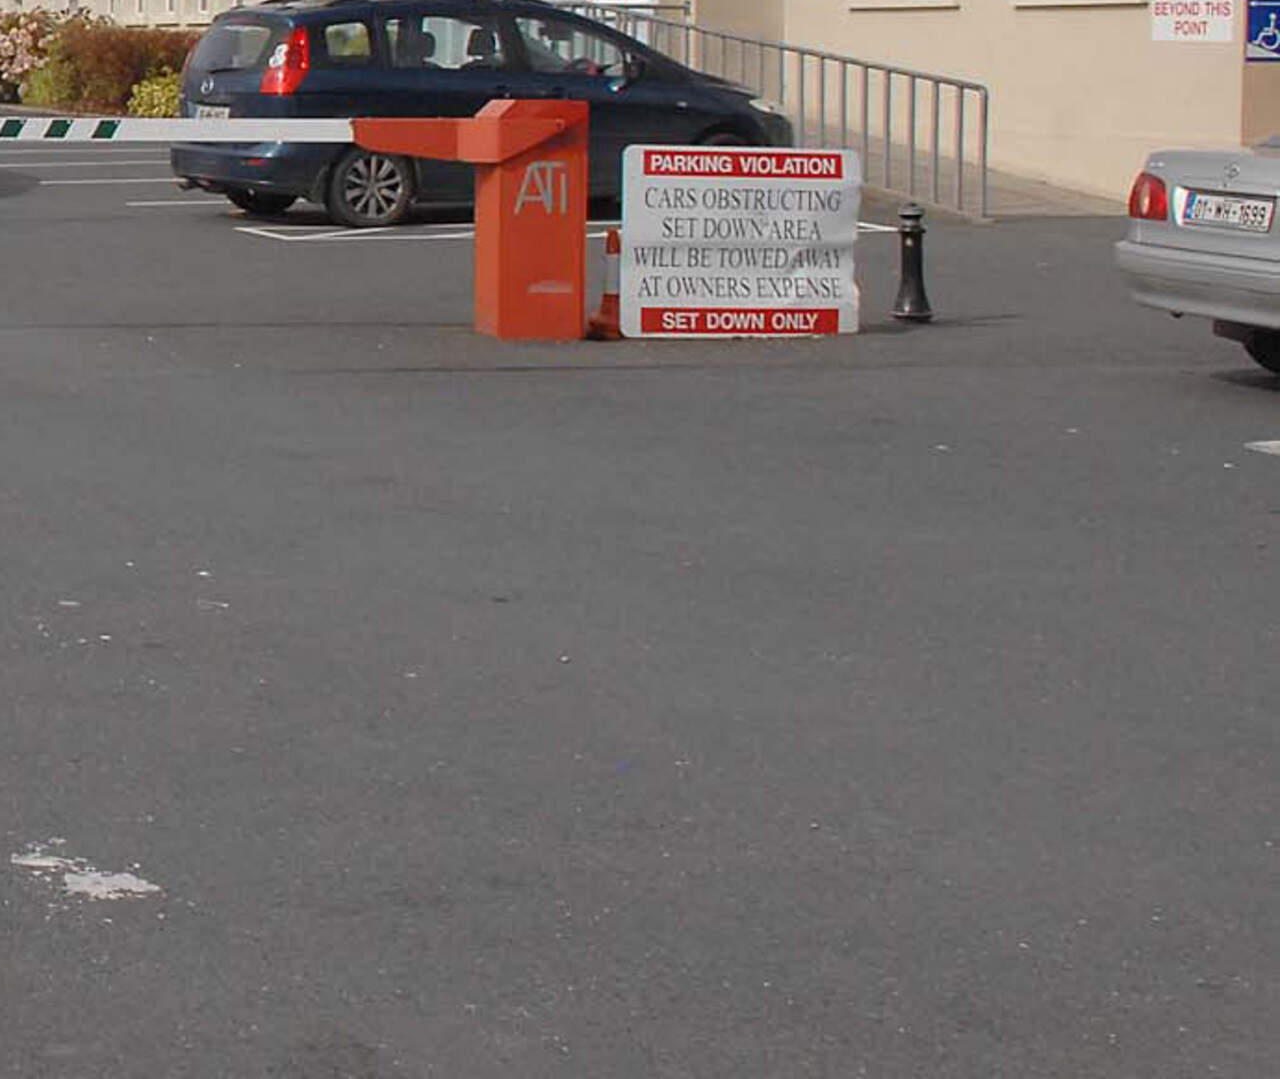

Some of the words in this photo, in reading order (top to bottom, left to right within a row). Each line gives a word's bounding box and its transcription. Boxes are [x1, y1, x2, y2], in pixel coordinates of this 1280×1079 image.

[1154, 1, 1199, 16] BEYOND
[1205, 2, 1231, 16] THIS
[1175, 21, 1208, 35] POINT
[650, 155, 733, 172] PARKING
[740, 157, 836, 175] VIOLATION
[644, 187, 698, 209] CARS
[702, 188, 841, 212] OBSTRUCTING
[662, 217, 699, 239] SET
[703, 219, 764, 240] DOWN
[767, 219, 822, 241] AREA
[633, 247, 682, 268] WILL
[687, 248, 714, 268] BE
[718, 248, 789, 269] TOWED
[791, 248, 842, 270] AWAY
[638, 276, 662, 298] AT
[666, 277, 751, 299] OWNERS
[756, 277, 842, 299] EXPENSE
[662, 312, 698, 330] SET
[706, 313, 765, 330] DOWN
[771, 312, 819, 330] ONLY
